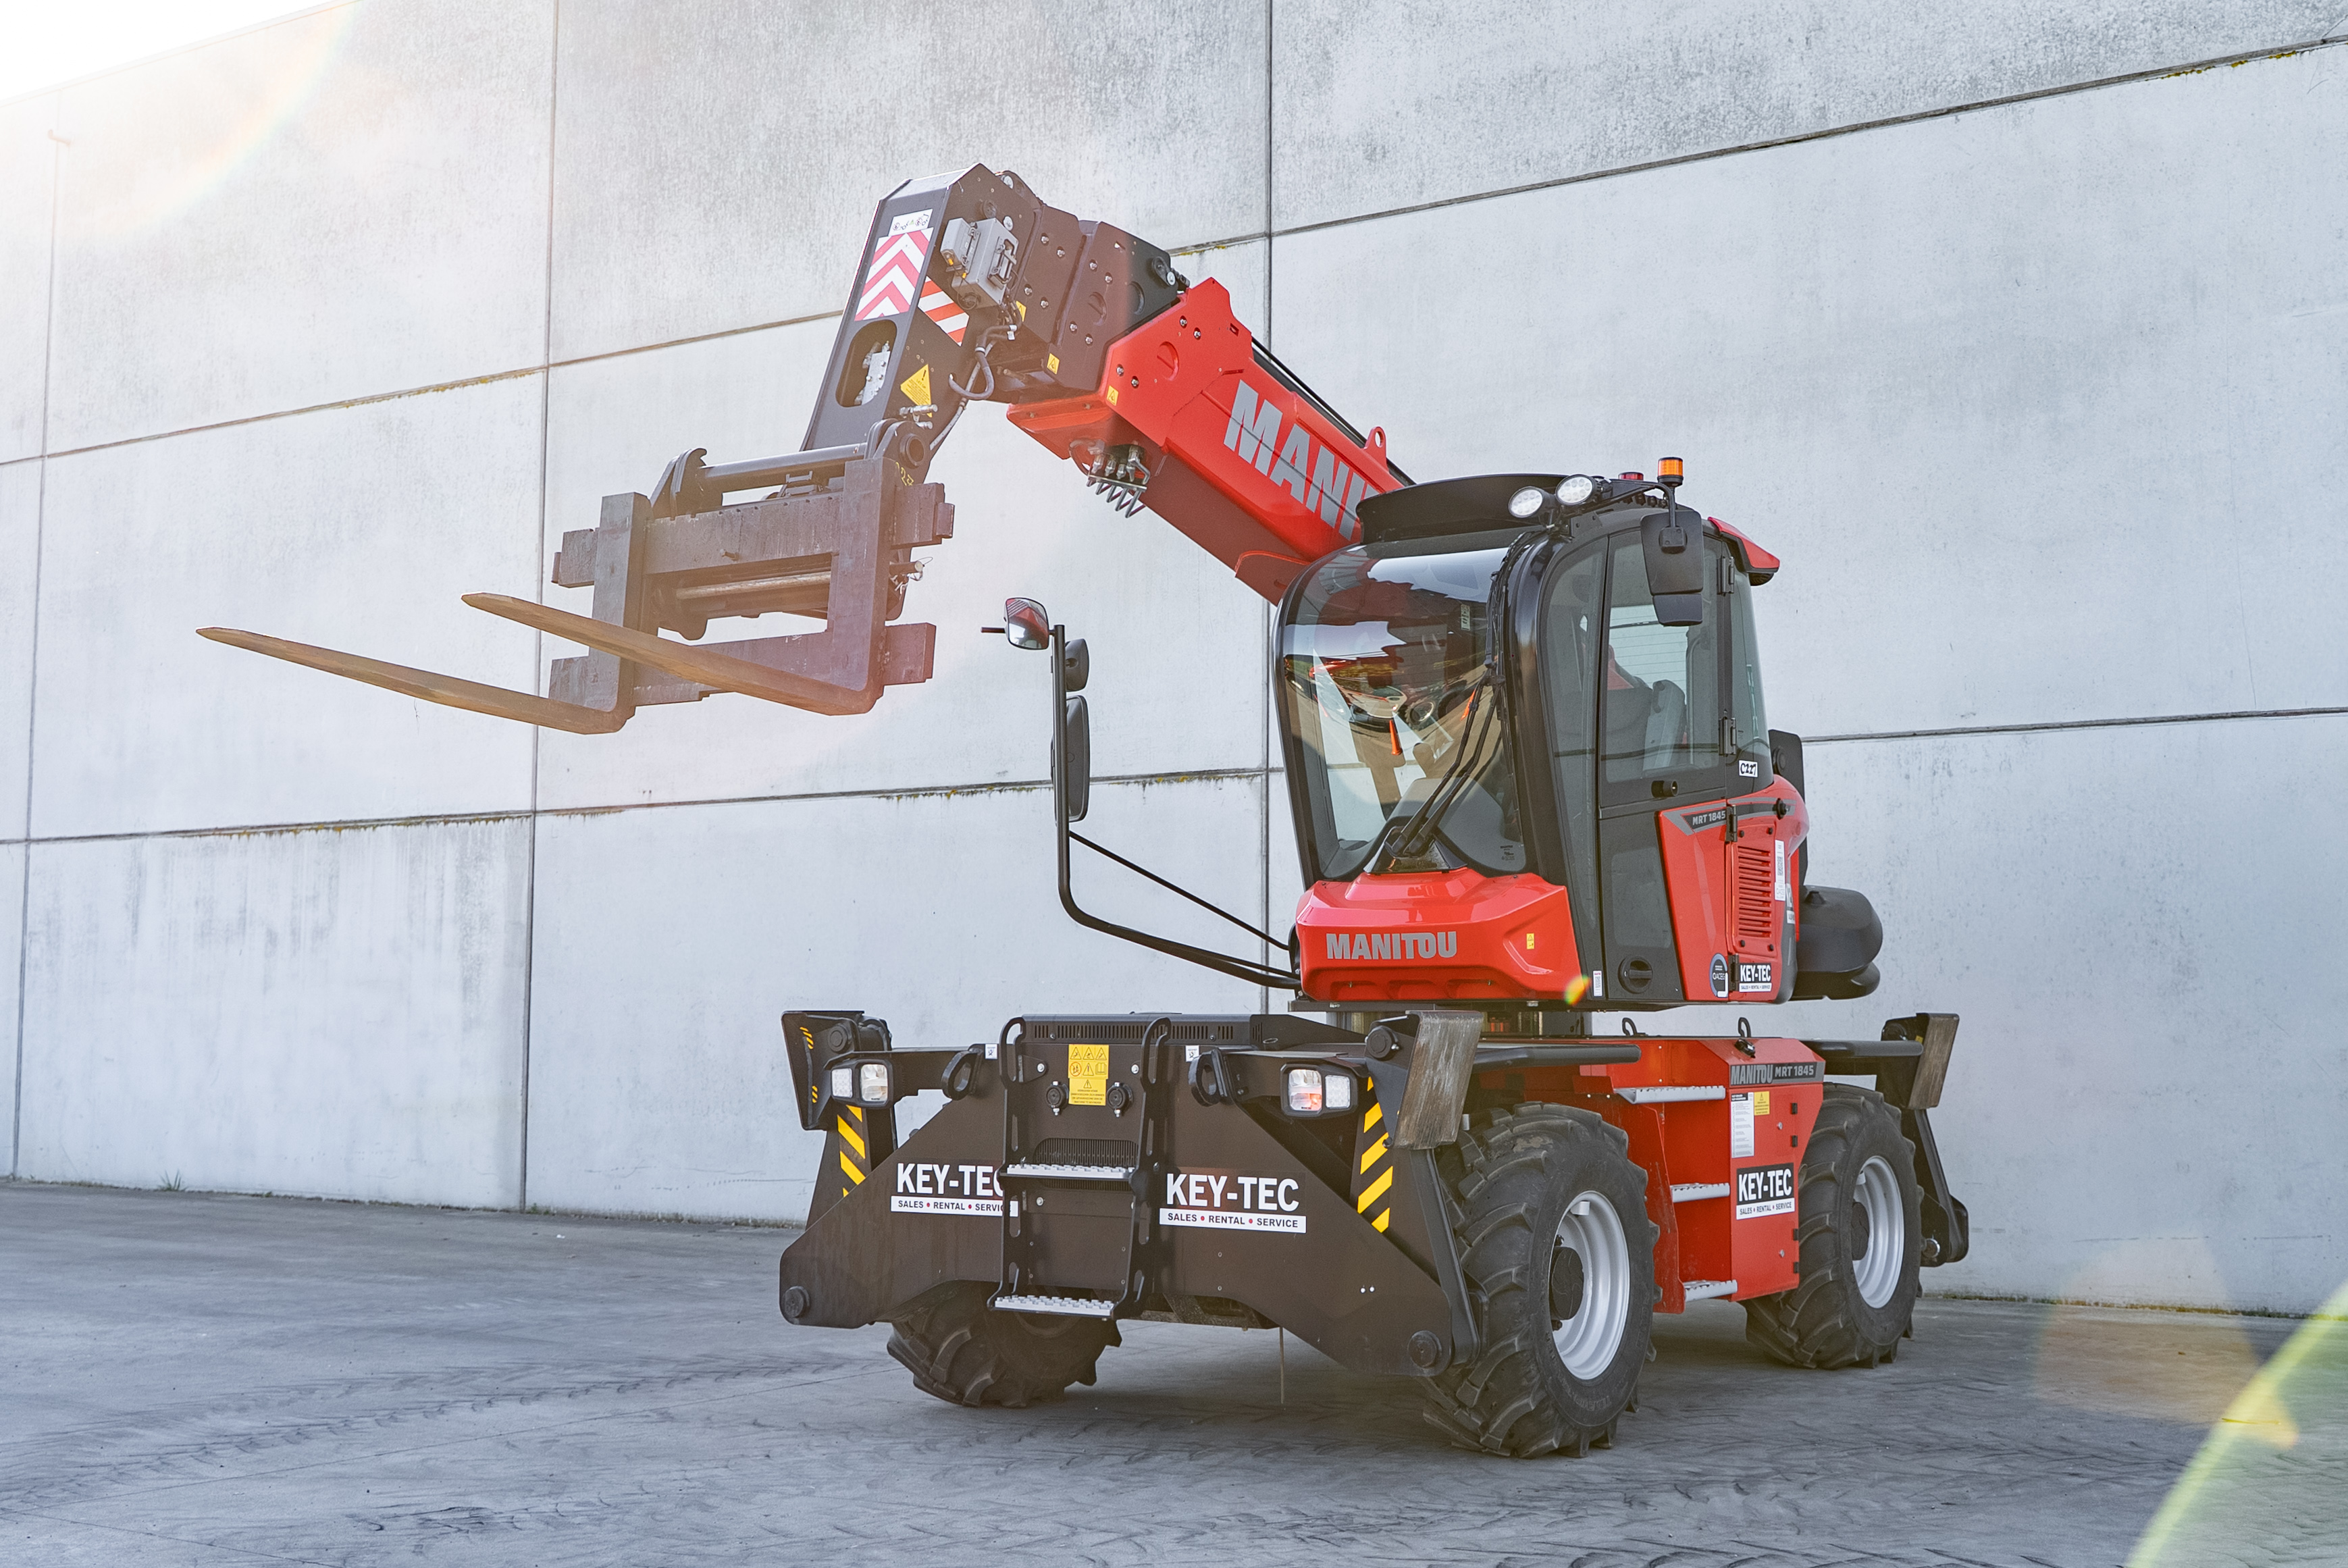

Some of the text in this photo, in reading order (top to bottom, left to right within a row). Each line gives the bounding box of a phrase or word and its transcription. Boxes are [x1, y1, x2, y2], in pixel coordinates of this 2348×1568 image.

[1224, 380, 1380, 541] MANI
[1692, 810, 1726, 825] MRT 1845
[1326, 931, 1457, 960] MANITOU
[1740, 964, 1771, 982] KEY-TEC
[1731, 1064, 1815, 1085] MANITOU MRT 1845
[1166, 1174, 1299, 1212] KEY-TEC
[1738, 1168, 1792, 1202] KEY-TEC
[898, 1200, 1011, 1213] SALES RENTAL SERVI
[1740, 1201, 1792, 1216] SALES RENTAL SERVICE
[1168, 1213, 1299, 1228] SALES RENTAL SERVICE
